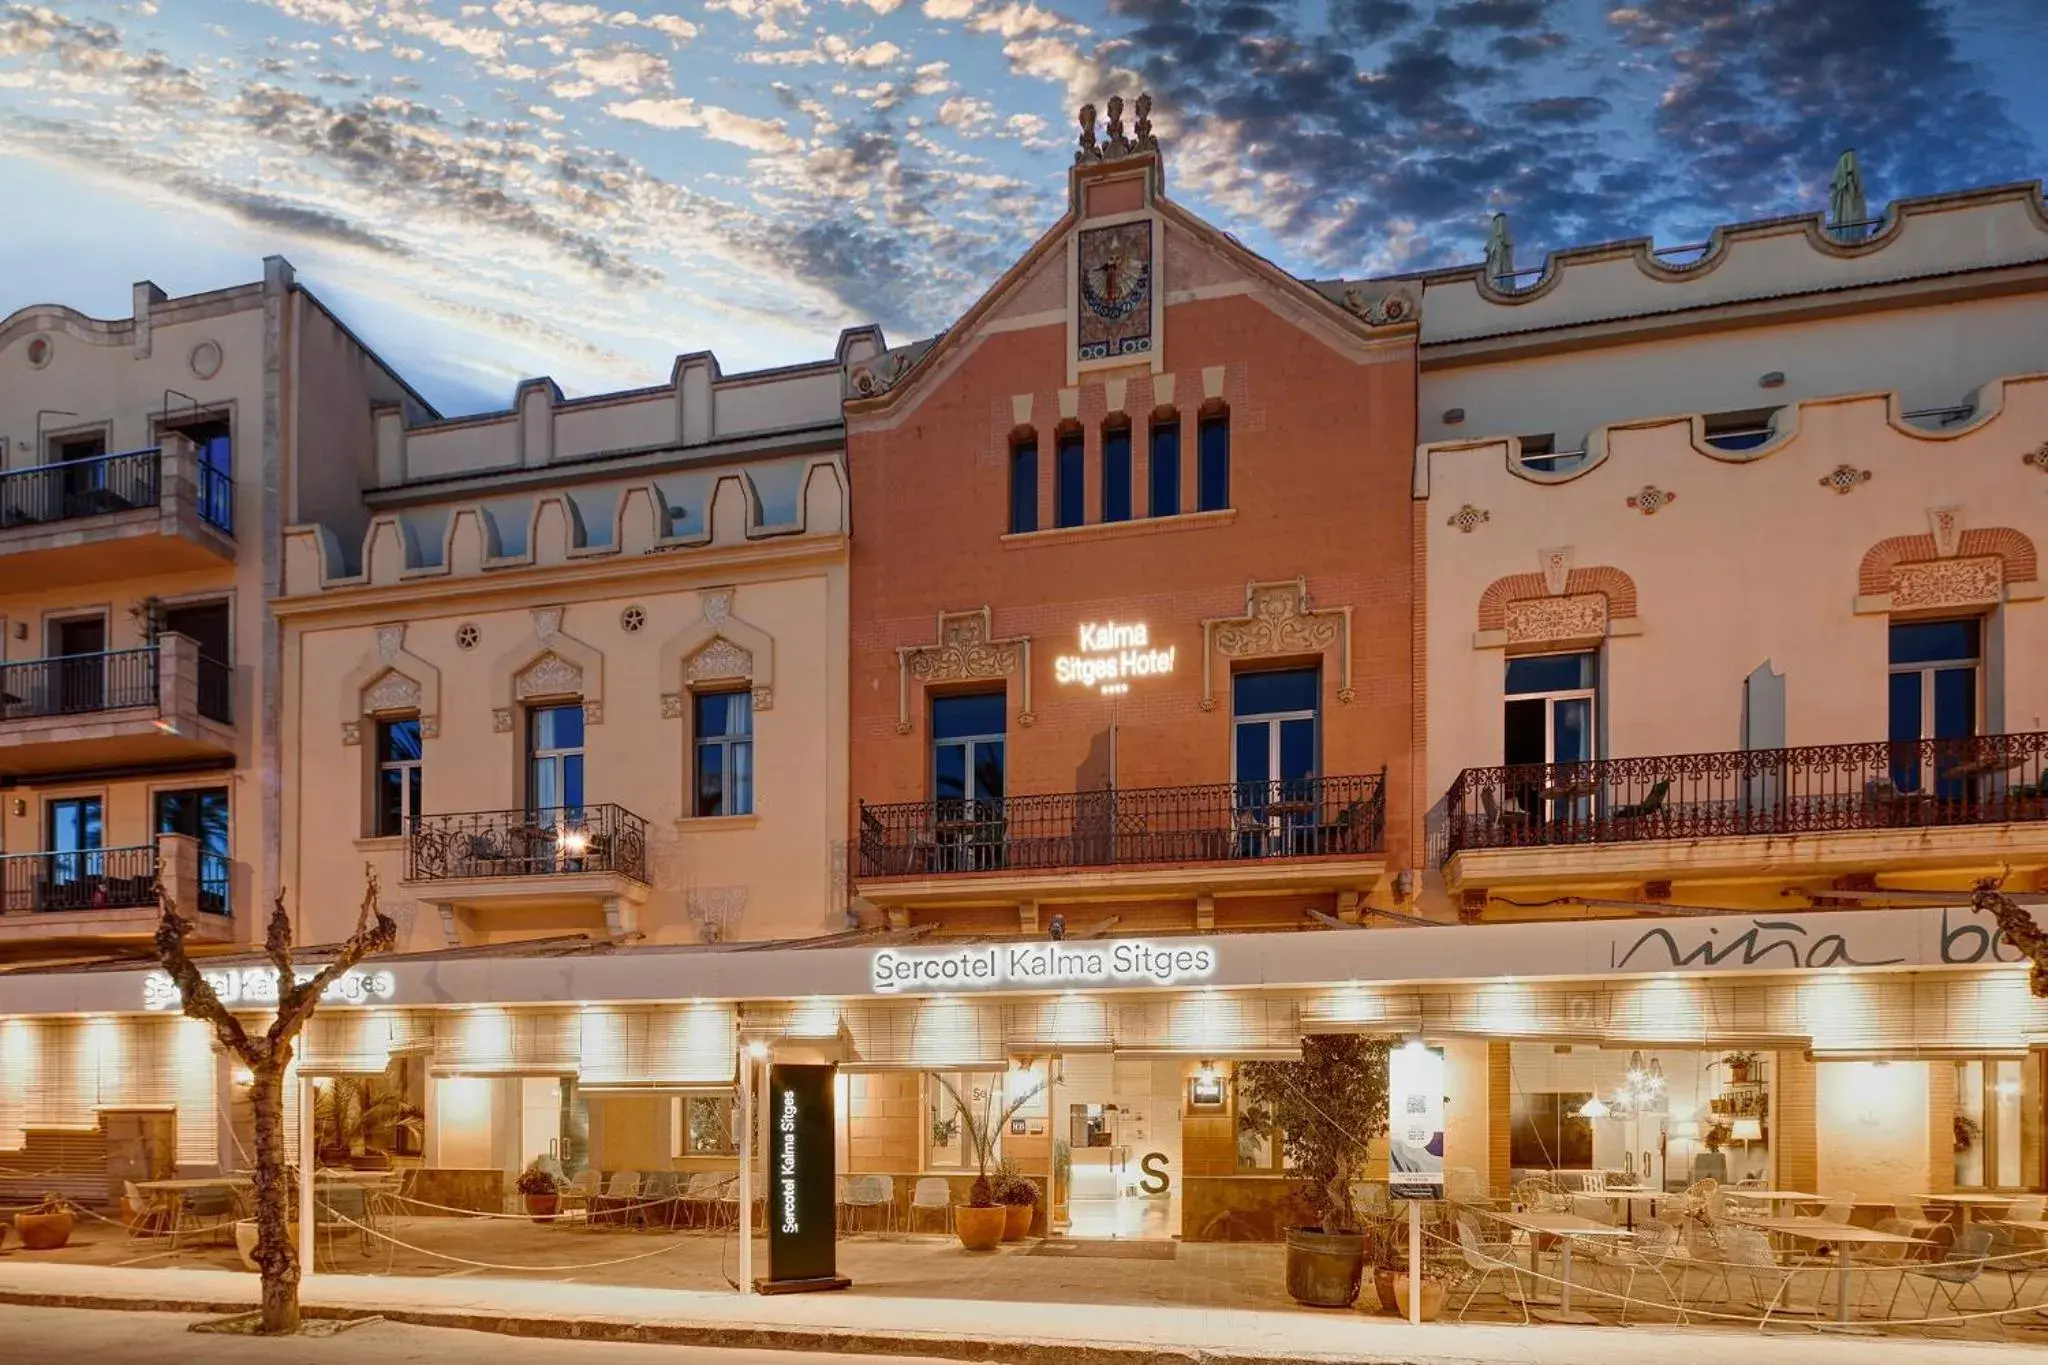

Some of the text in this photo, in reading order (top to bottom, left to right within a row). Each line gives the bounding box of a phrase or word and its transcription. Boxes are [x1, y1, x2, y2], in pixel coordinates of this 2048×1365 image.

[1079, 621, 1148, 652] Kalma
[1055, 644, 1175, 686] Sitges Hotel
[1611, 919, 1905, 968] niña
[876, 944, 1210, 988] Sercotel Kalma Sitges
[781, 1090, 798, 1233] Sercotel Kalma Sitges
[1140, 1152, 1169, 1194] S
